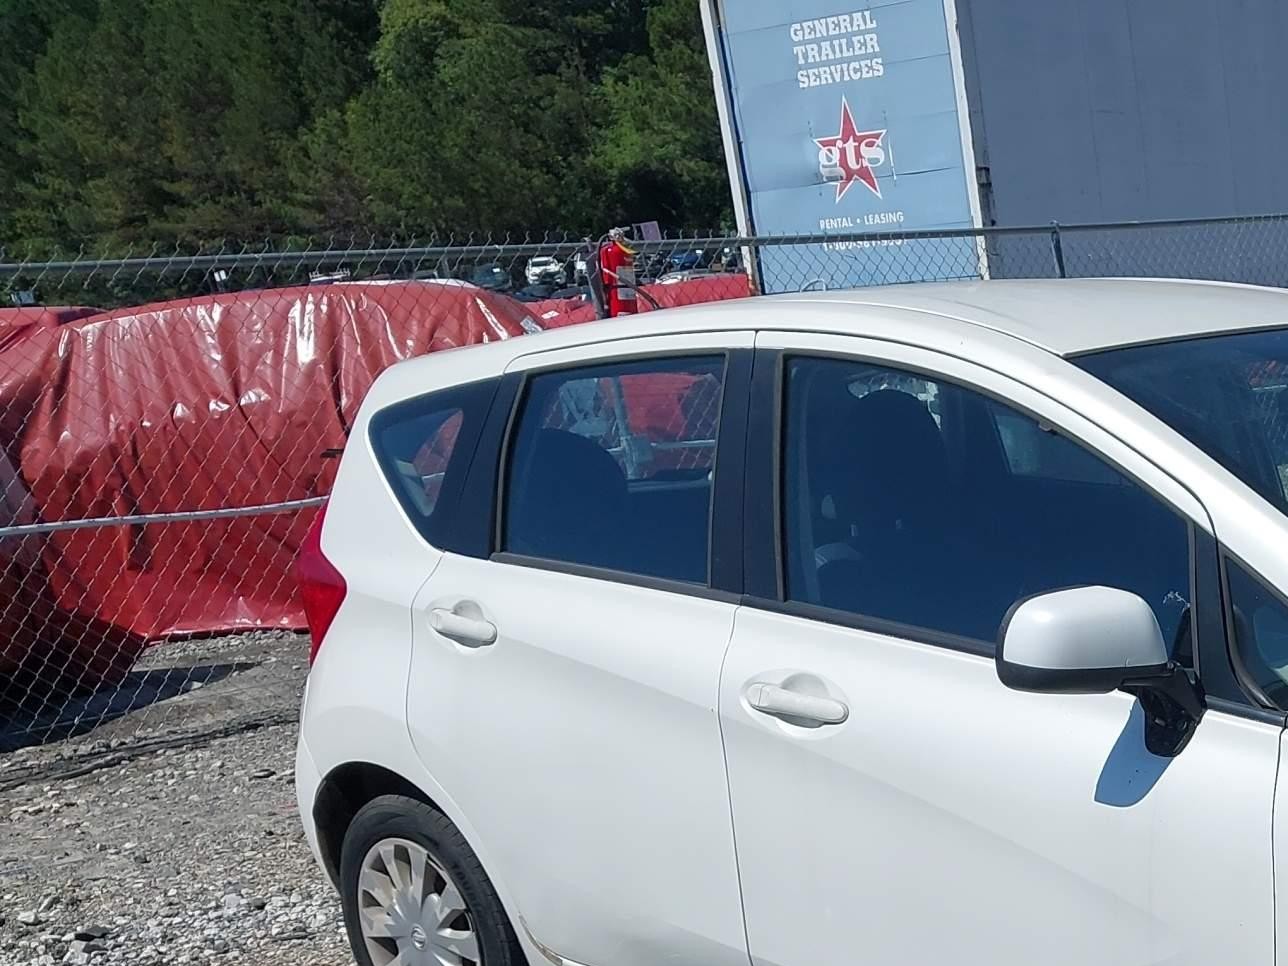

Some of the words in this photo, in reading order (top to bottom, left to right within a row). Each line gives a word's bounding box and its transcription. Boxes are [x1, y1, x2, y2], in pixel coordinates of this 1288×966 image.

[790, 10, 877, 42] GENERAL
[793, 33, 880, 65] TRAILER
[797, 58, 884, 89] SERVICES
[818, 135, 885, 183] gts
[820, 216, 853, 230] RENTAL
[864, 211, 904, 225] LEASING
